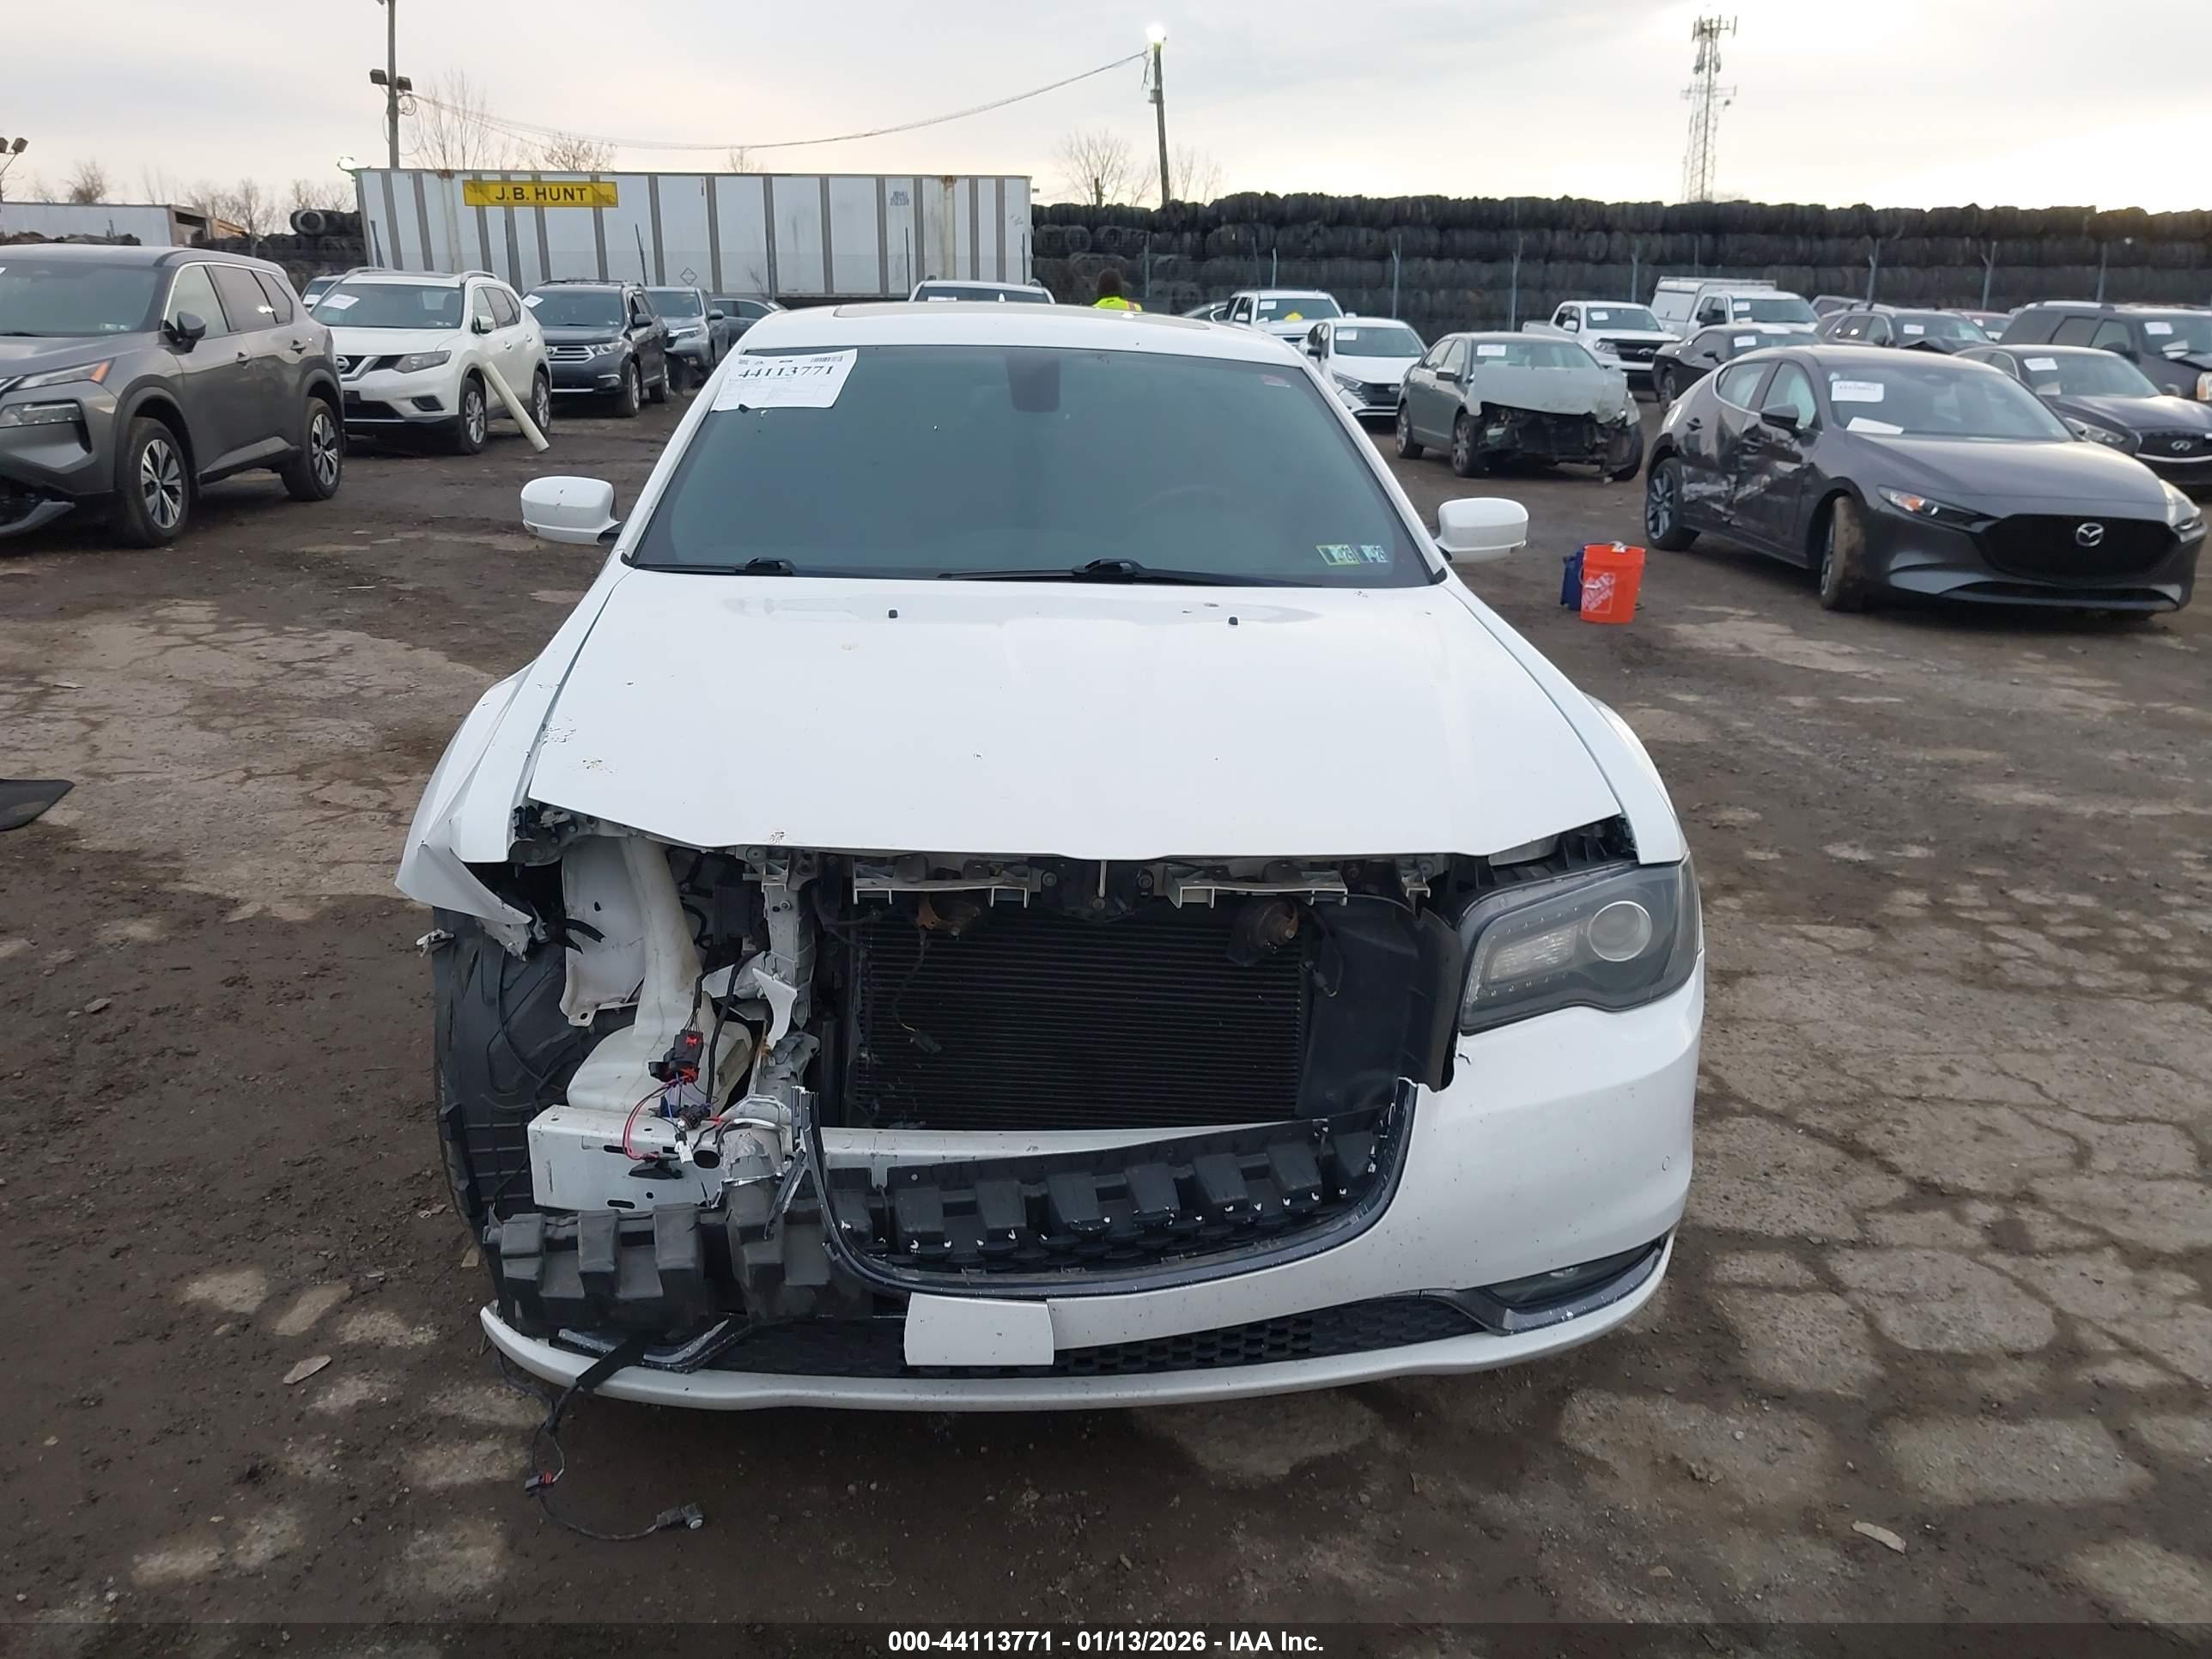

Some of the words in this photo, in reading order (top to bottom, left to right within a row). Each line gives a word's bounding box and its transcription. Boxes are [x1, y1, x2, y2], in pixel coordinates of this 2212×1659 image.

[495, 187, 530, 201] J.B.
[535, 187, 586, 201] HUNT
[738, 365, 835, 379] 44113771
